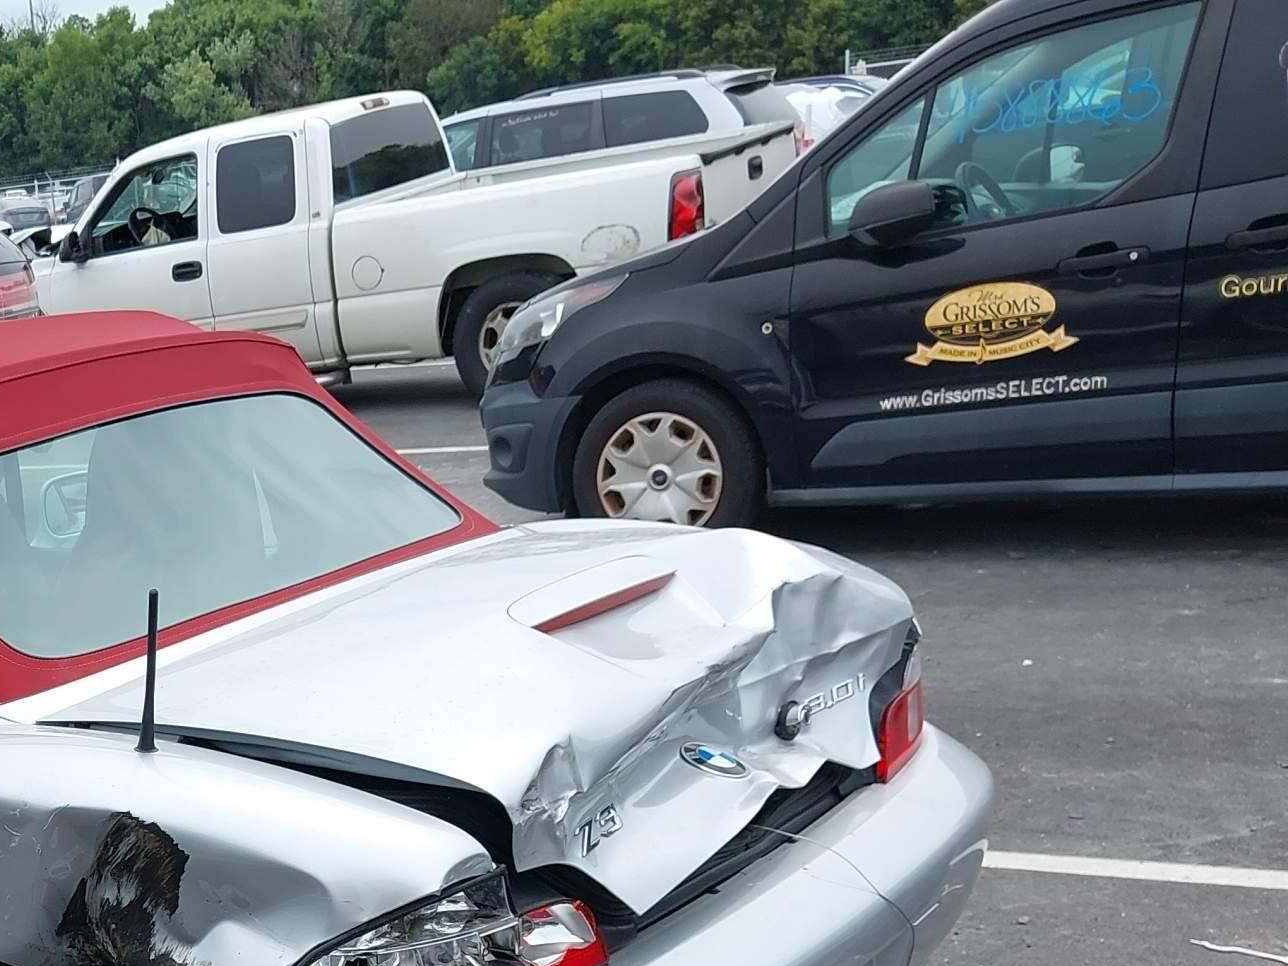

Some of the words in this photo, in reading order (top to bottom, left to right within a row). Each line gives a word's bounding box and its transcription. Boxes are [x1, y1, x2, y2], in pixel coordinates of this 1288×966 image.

[1219, 274, 1288, 299] Gour
[951, 316, 1032, 336] SELECT
[1018, 337, 1041, 350] CITY
[879, 375, 1108, 411] www.GrissomsSELECT.com
[574, 802, 623, 857] Z3
